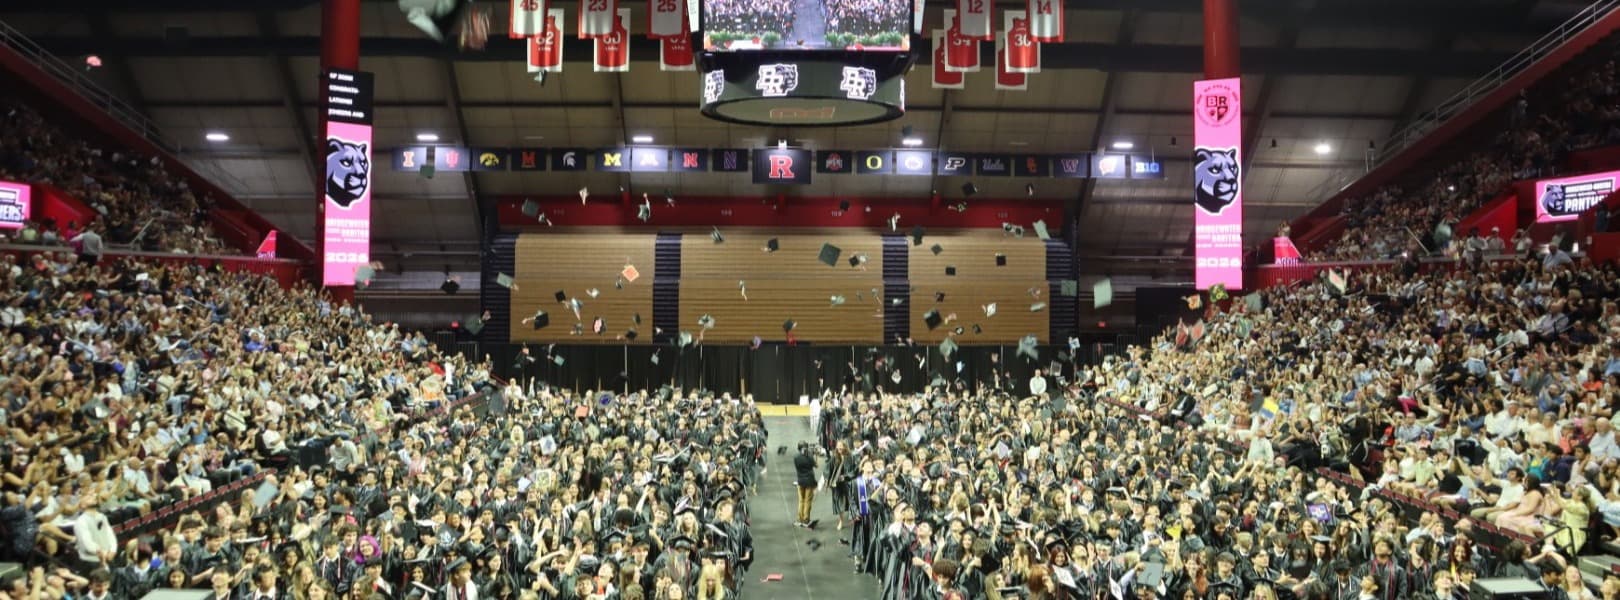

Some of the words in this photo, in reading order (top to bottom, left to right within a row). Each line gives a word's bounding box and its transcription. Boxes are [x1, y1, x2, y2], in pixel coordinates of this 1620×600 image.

[657, 0, 677, 13] 25
[967, 0, 983, 14] 12
[1037, 0, 1053, 14] 14
[604, 153, 622, 167] M
[683, 153, 699, 168] N
[769, 155, 795, 178] R
[866, 155, 883, 169] O
[945, 157, 966, 170] P
[1061, 159, 1079, 173] W
